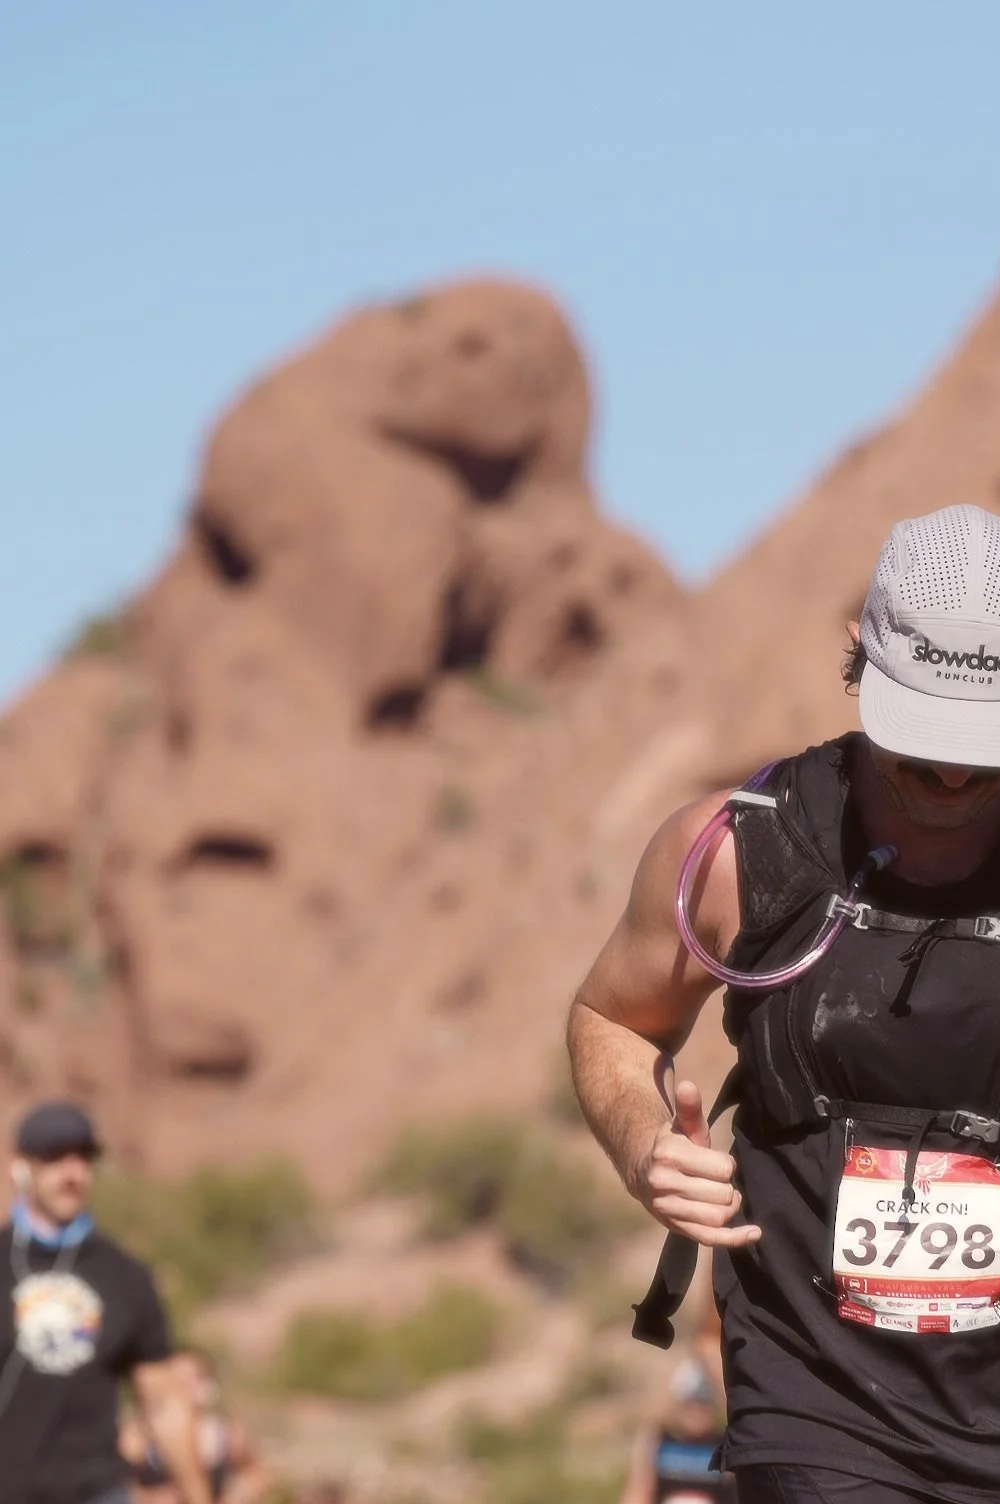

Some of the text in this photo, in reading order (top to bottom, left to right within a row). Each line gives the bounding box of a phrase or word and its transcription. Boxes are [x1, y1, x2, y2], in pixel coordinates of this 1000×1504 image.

[876, 1200, 968, 1216] CRACK ON!
[842, 1217, 996, 1270] 3798
